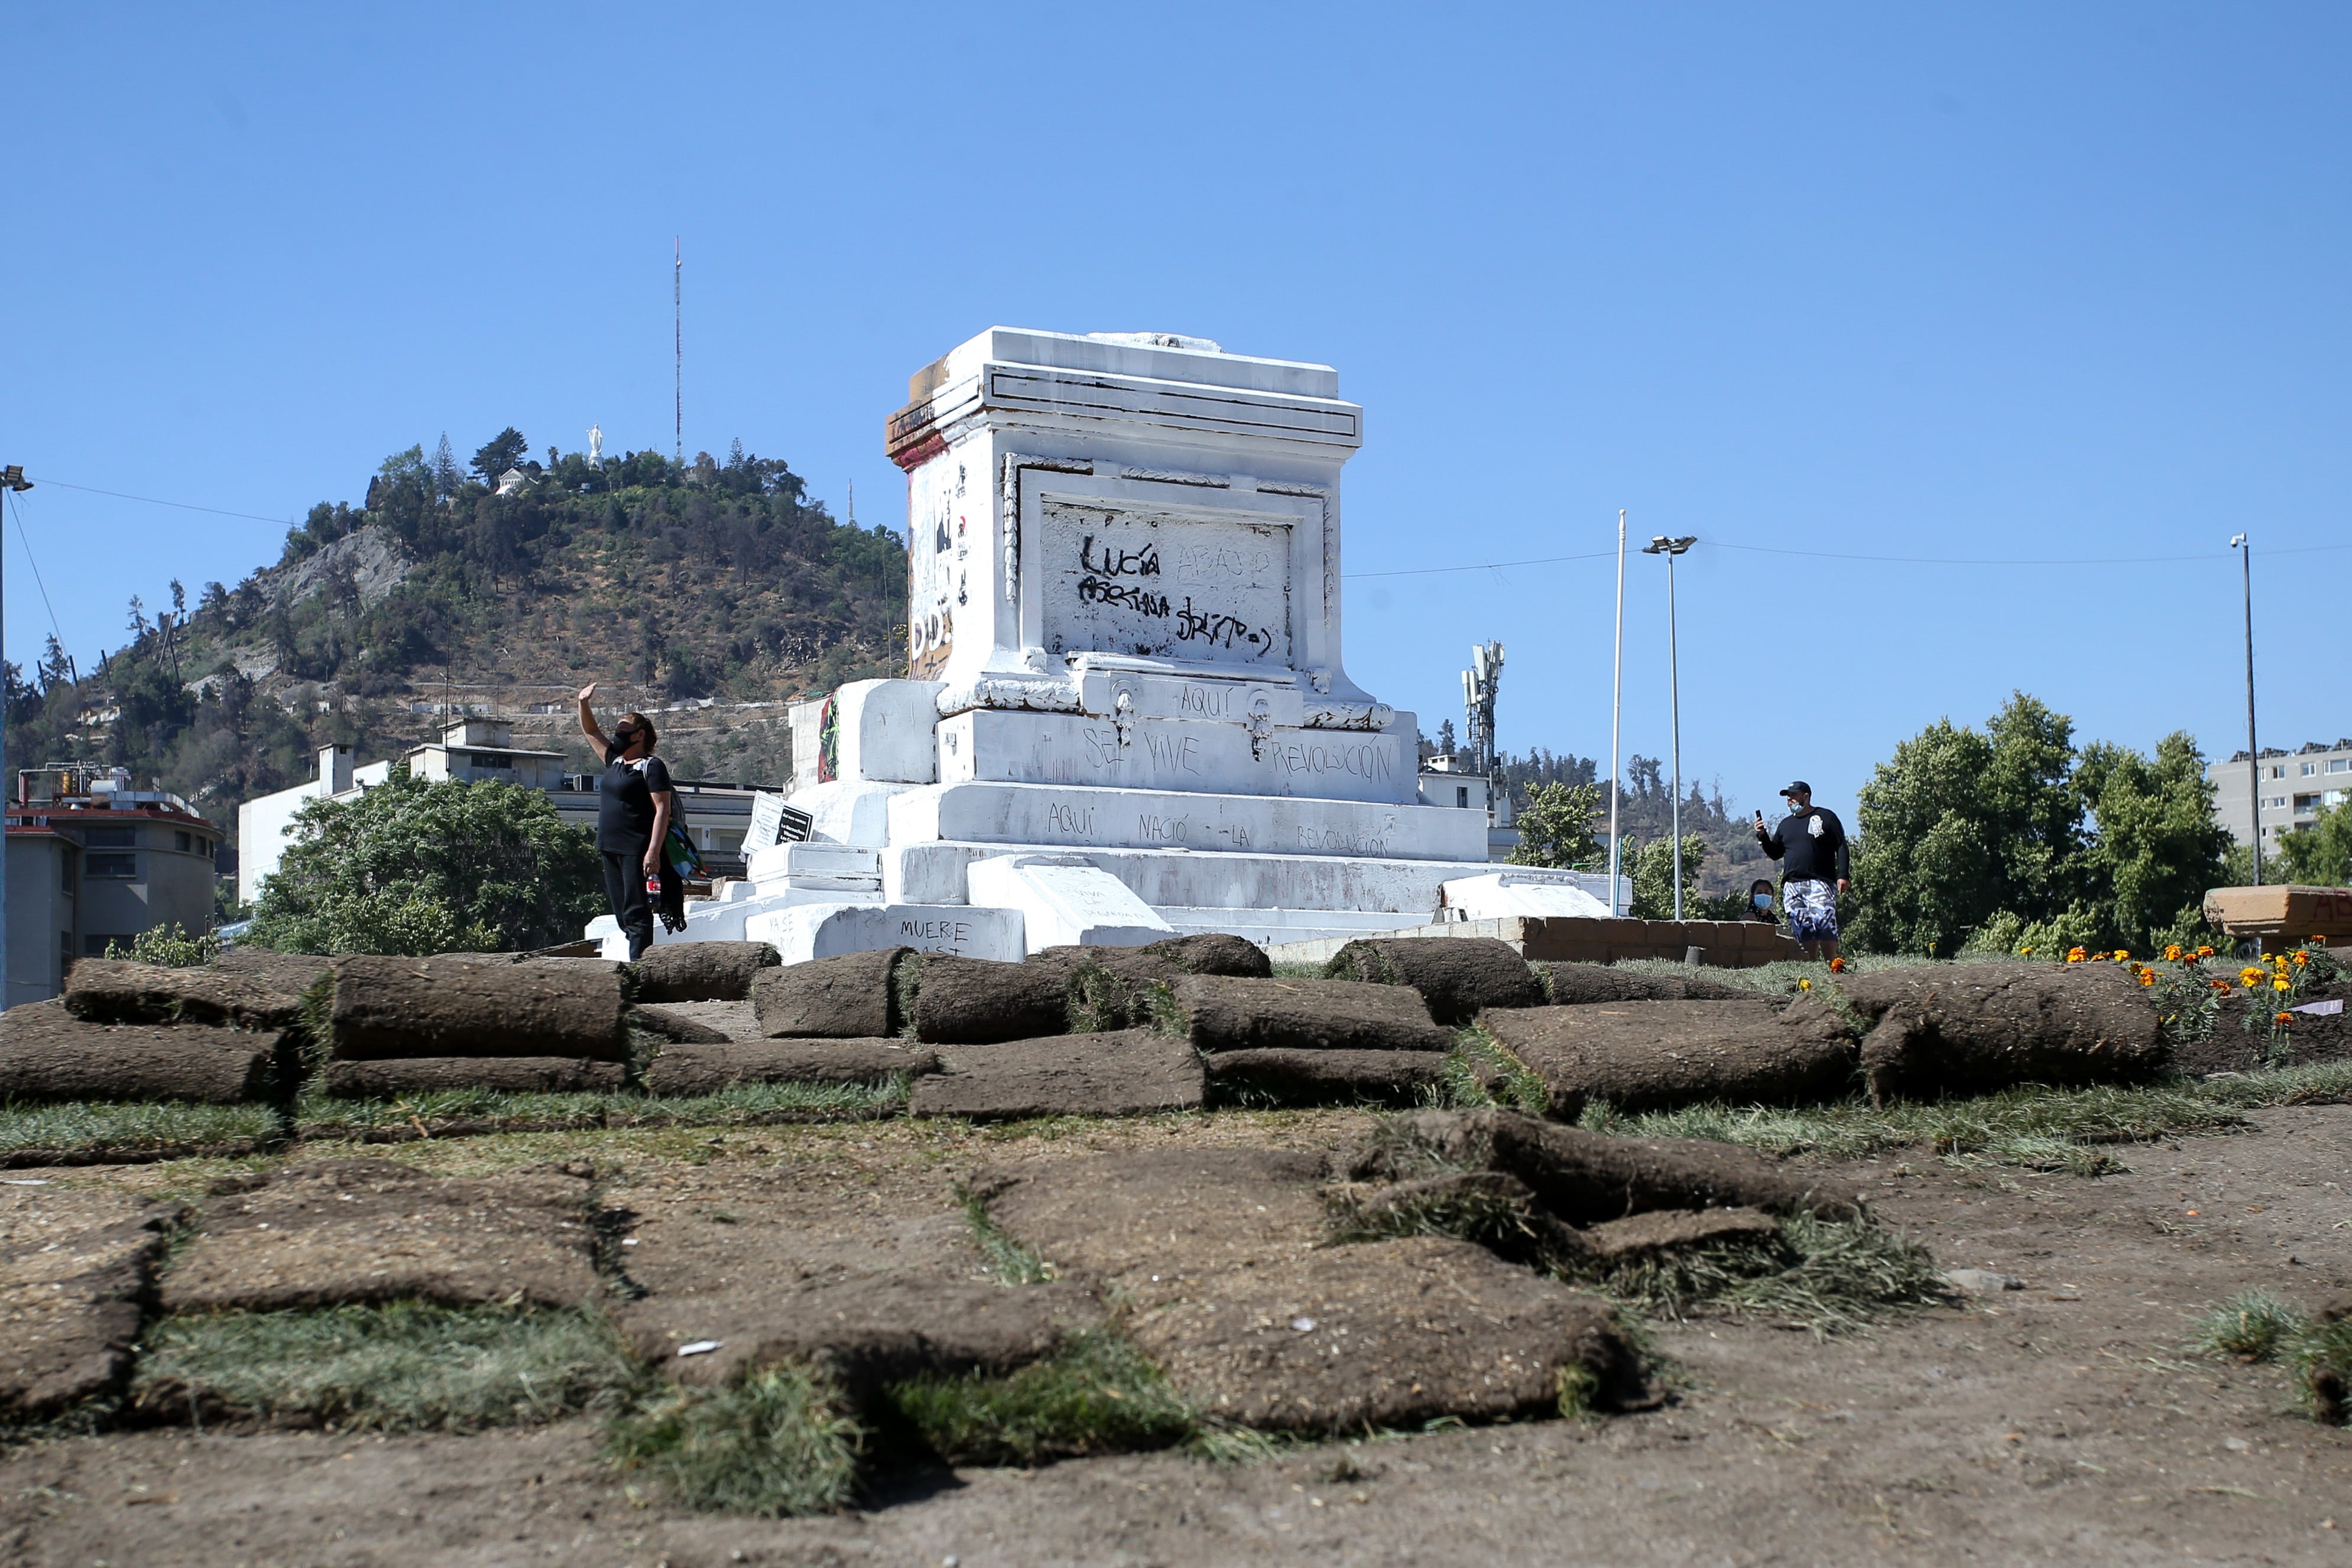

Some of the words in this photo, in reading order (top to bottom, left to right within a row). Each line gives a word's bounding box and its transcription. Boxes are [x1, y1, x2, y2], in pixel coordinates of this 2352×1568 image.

[1081, 535, 1160, 577] LUCÍA
[1181, 685, 1234, 718] AQUÍ
[1083, 728, 1124, 768] SE
[1271, 735, 1392, 784] REVOLUCIÓN
[1232, 824, 1250, 847] LA
[901, 920, 972, 943] MUERE
